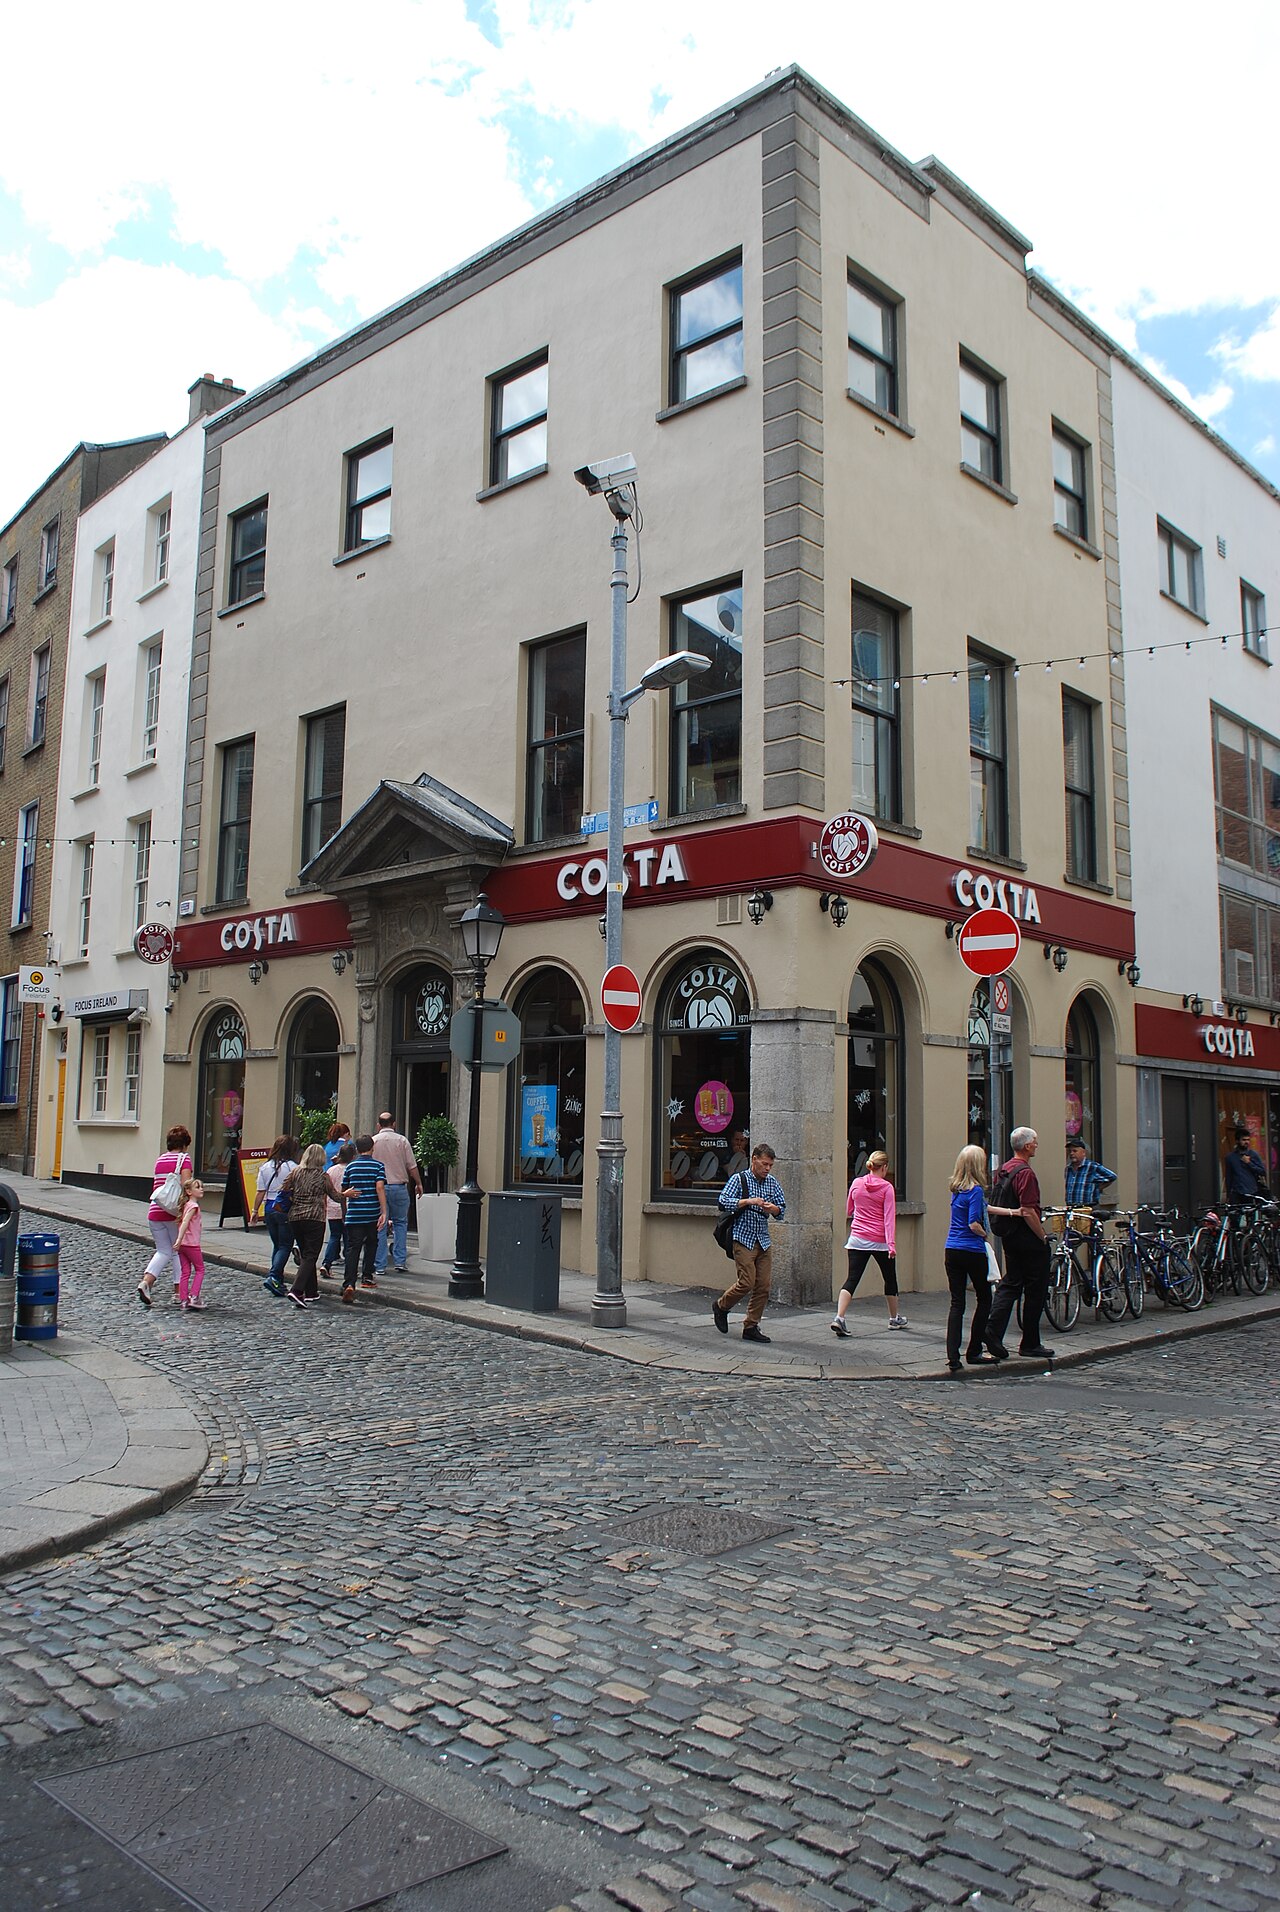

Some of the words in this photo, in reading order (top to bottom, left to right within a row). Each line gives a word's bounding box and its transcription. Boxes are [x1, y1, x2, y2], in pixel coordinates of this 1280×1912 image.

[828, 816, 862, 834] COSTA
[824, 850, 866, 872] COFFEE
[954, 869, 1042, 924] COSTA
[143, 926, 168, 937] COSTA
[221, 913, 297, 951] COSTA
[140, 947, 170, 962] COFFEE
[22, 984, 50, 994] Focus
[421, 980, 446, 996] COSTA
[680, 966, 738, 998] COSTA
[25, 992, 47, 1000] Ireland
[74, 1000, 92, 1012] FOCUS
[93, 996, 118, 1009] IRELAND
[418, 1014, 449, 1034] COFFEE
[669, 1018, 684, 1028] SINCE
[738, 1014, 749, 1023] 1971
[1205, 1024, 1255, 1059] COSTA
